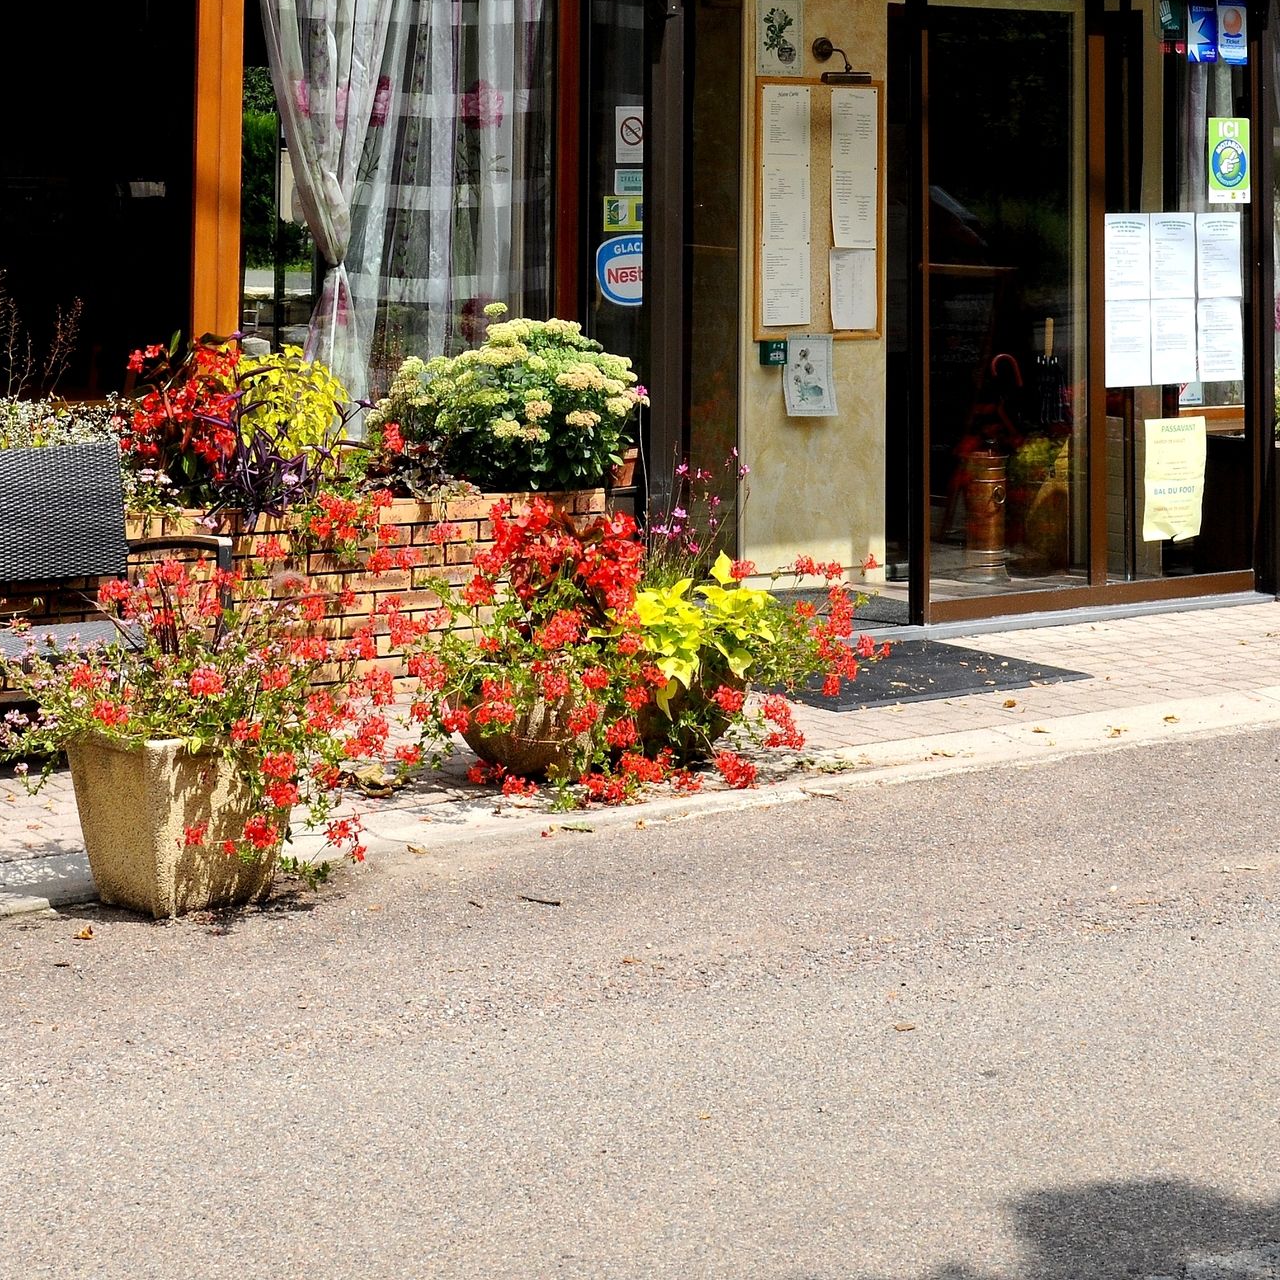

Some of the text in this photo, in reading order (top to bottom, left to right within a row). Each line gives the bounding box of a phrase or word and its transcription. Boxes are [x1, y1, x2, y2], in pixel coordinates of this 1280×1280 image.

[1218, 121, 1239, 138] ICI
[1161, 424, 1196, 433] PASSAVANT
[1168, 487, 1178, 495] DU
[1179, 486, 1195, 494] FOOT
